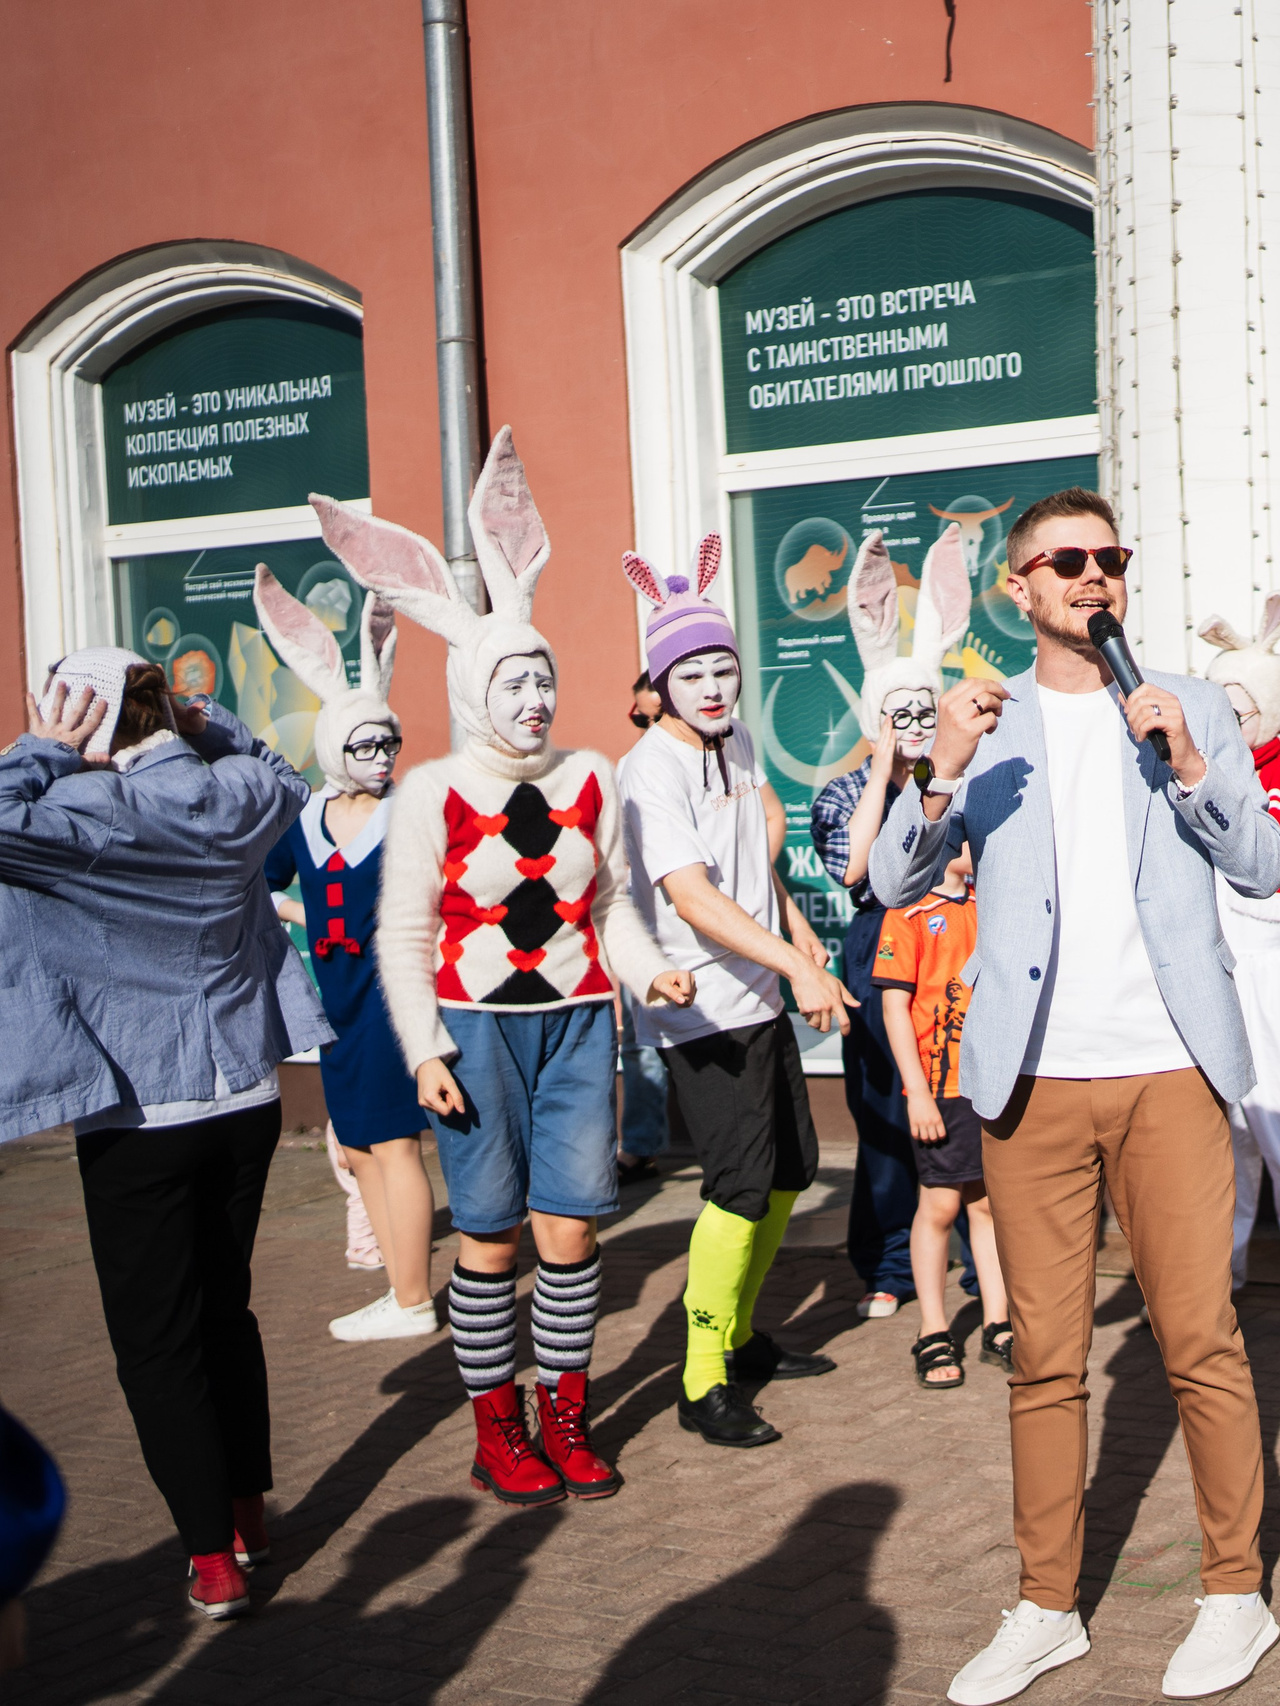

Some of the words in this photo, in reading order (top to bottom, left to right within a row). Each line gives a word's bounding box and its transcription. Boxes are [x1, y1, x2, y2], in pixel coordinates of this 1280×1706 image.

[744, 296, 816, 335] МУЗЕЙ
[835, 293, 876, 323] ЭТО
[880, 279, 977, 317] ВСТРЕЧА
[747, 346, 762, 373] С
[763, 321, 949, 371] ТАИНСТВЕННЫМИ
[123, 391, 177, 425] МУЗЕЙ
[191, 391, 221, 417] ЭТО
[224, 374, 333, 412] УНИКАЛЬНАЯ
[749, 367, 899, 410] ОБИТАТЕЛЯМИ
[903, 351, 1023, 391] ПРОШЛОГО
[126, 423, 219, 457] КОЛЛЕКЦИЯ
[222, 411, 310, 445] ПОЛЕЗНЫХ
[127, 454, 234, 489] ИСКОПАЕМЫХ
